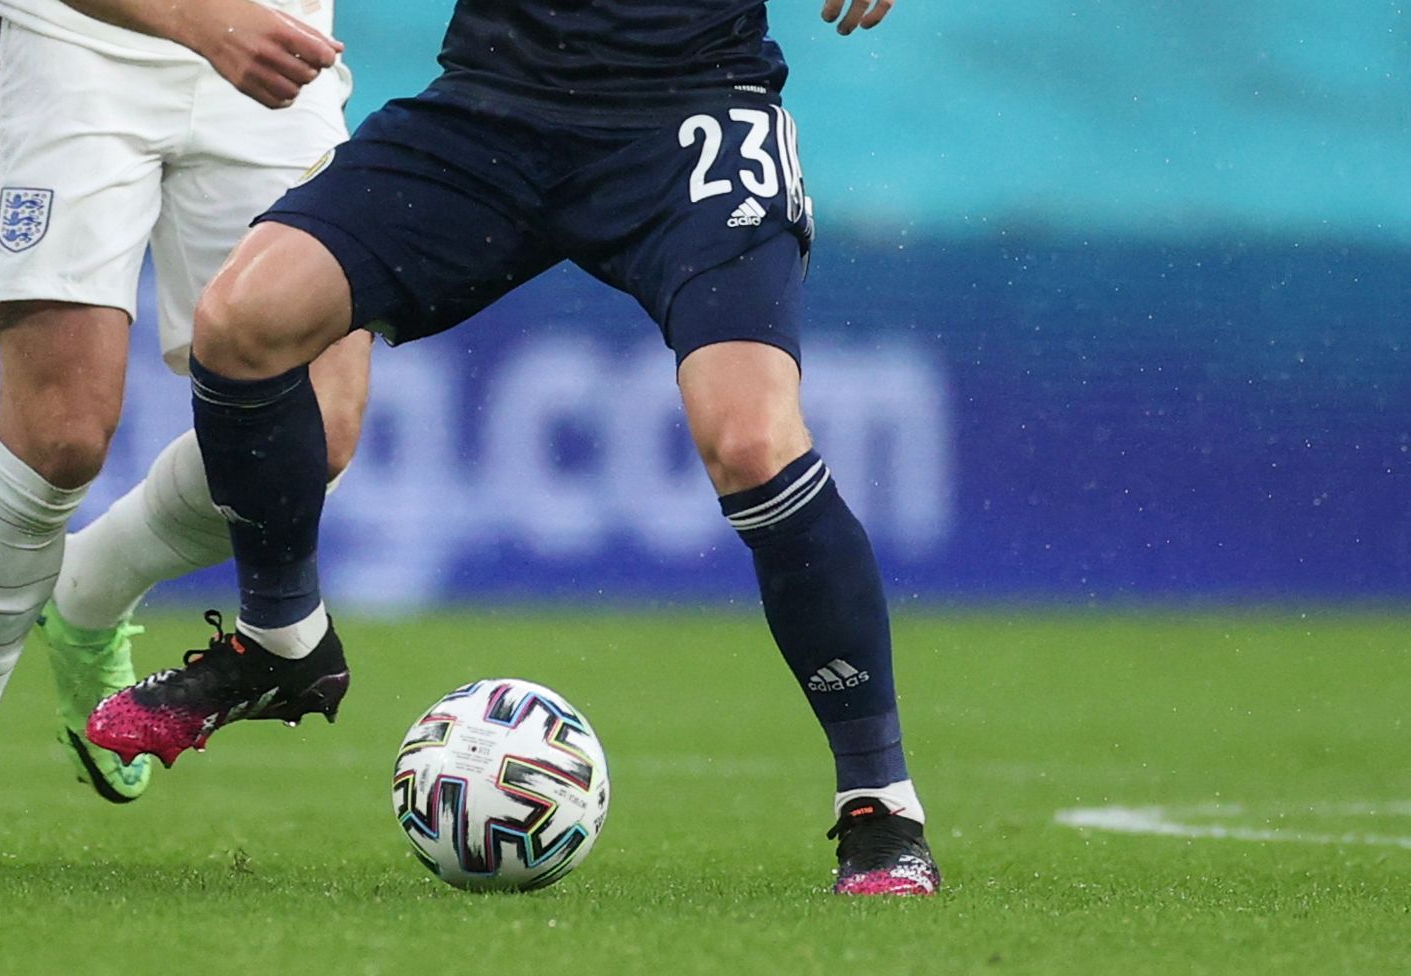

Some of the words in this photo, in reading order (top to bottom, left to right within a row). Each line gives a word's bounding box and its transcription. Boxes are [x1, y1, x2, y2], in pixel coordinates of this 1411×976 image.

[677, 107, 780, 204] 23
[726, 216, 762, 228] adid
[808, 670, 870, 692] adidas
